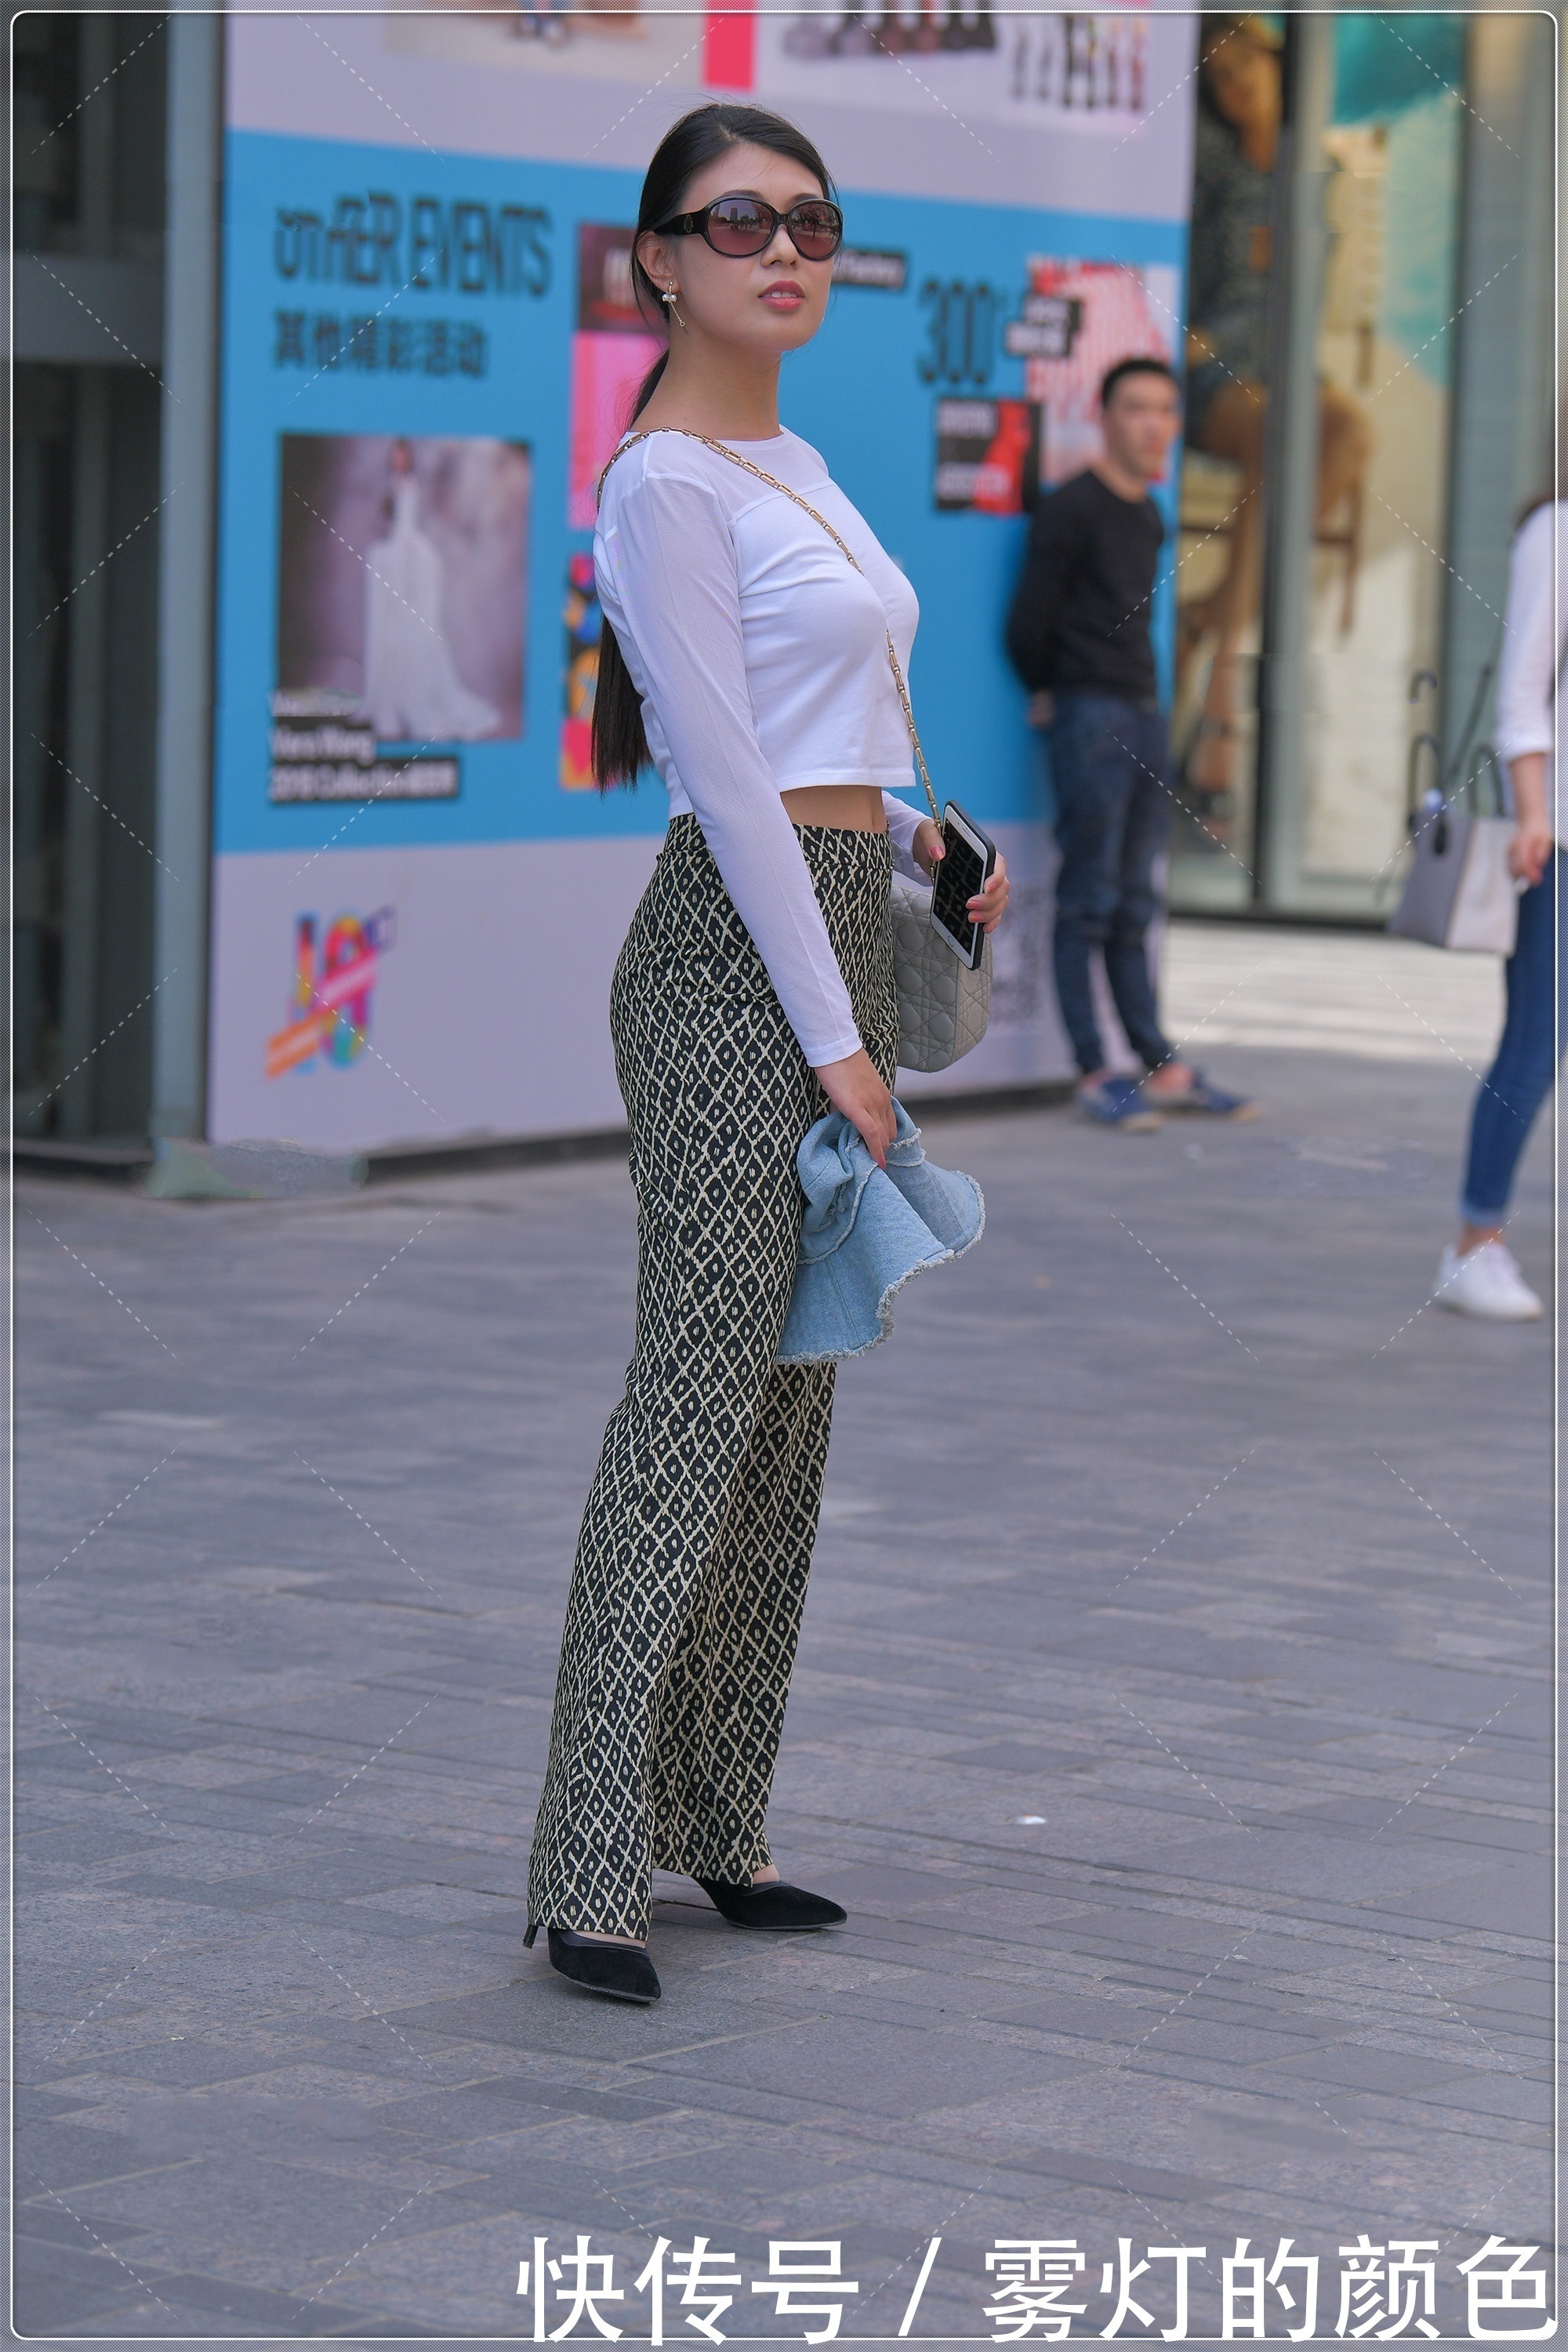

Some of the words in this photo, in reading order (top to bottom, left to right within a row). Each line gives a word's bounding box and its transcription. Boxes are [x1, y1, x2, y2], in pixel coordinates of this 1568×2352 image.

[409, 196, 554, 296] EVENTS
[275, 311, 486, 378] 其他精彩活动
